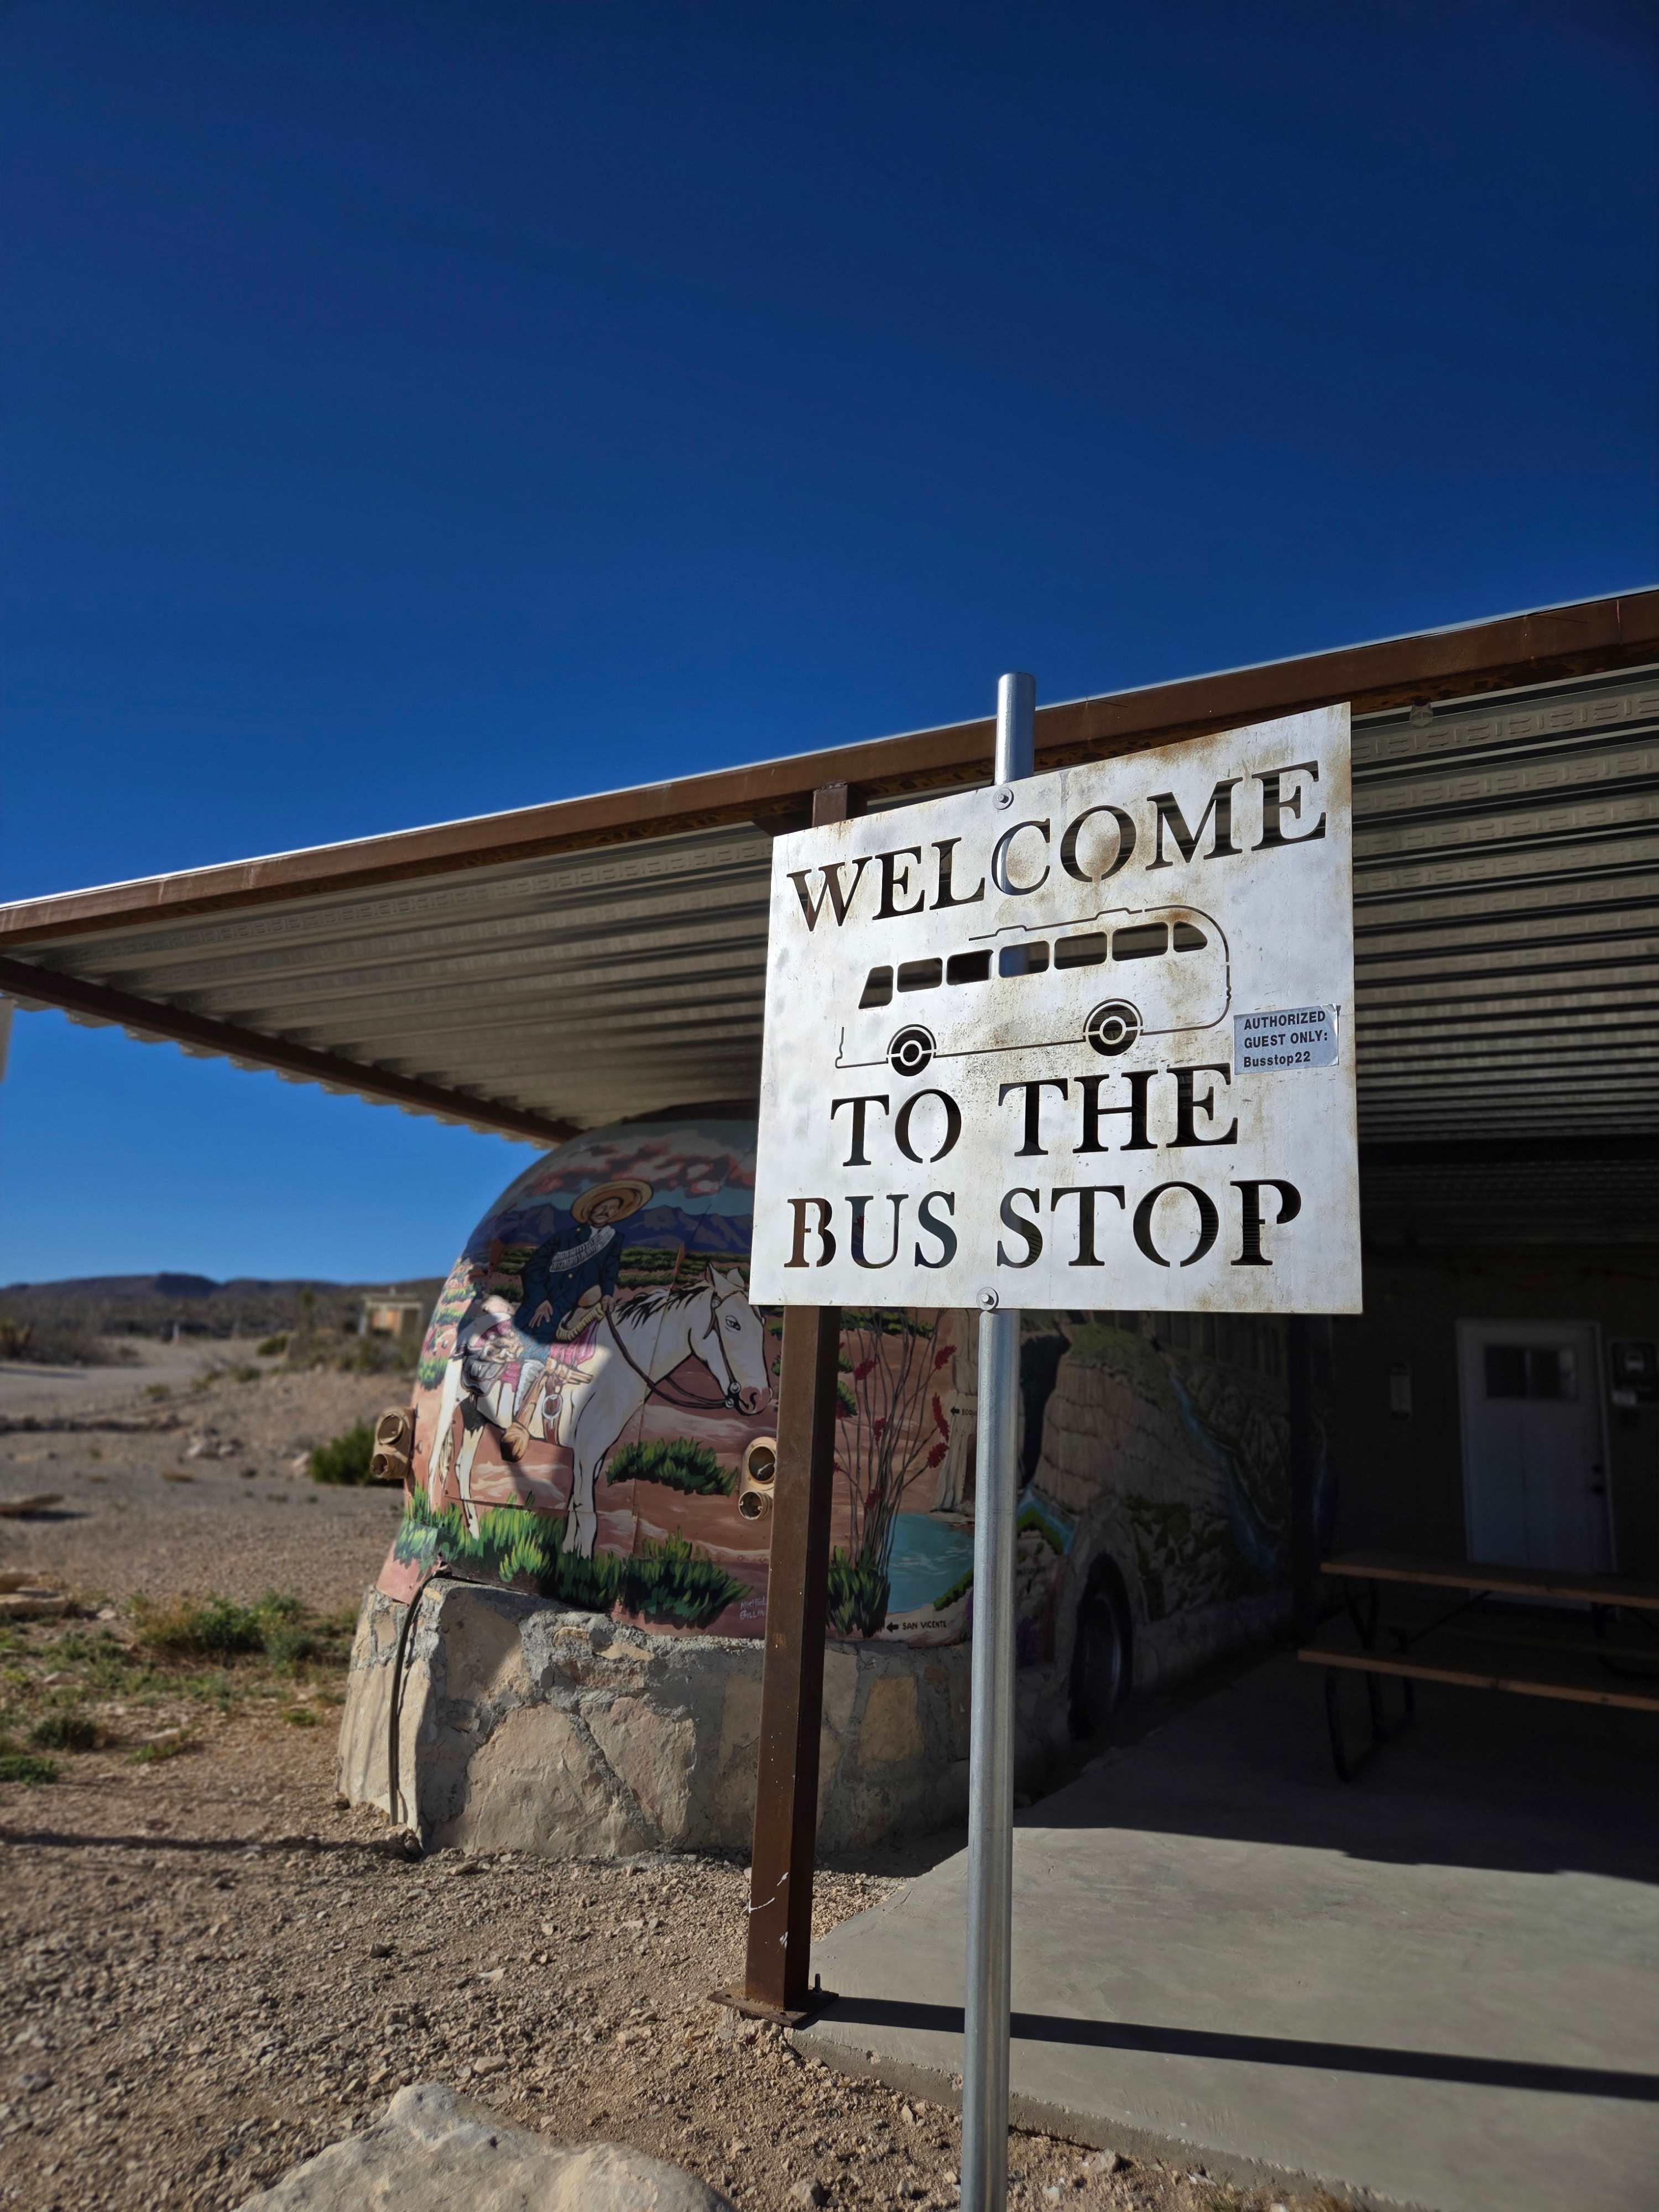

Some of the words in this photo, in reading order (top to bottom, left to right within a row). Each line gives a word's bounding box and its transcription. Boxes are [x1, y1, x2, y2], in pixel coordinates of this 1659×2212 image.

[786, 760, 1327, 932] WELCOME
[1244, 1010, 1326, 1030] AUTHORIZED
[1244, 1034, 1286, 1048] GUEST
[1290, 1029, 1328, 1044] ONLY:
[1244, 1051, 1311, 1068] Busstop22
[830, 1088, 962, 1167] TO
[998, 1062, 1238, 1157] THE
[784, 1191, 957, 1269] BUS
[997, 1179, 1302, 1269] STOP
[739, 1610, 765, 1620] BILLIN
[902, 1622, 918, 1630] SAN
[920, 1620, 947, 1629] VICENTE
